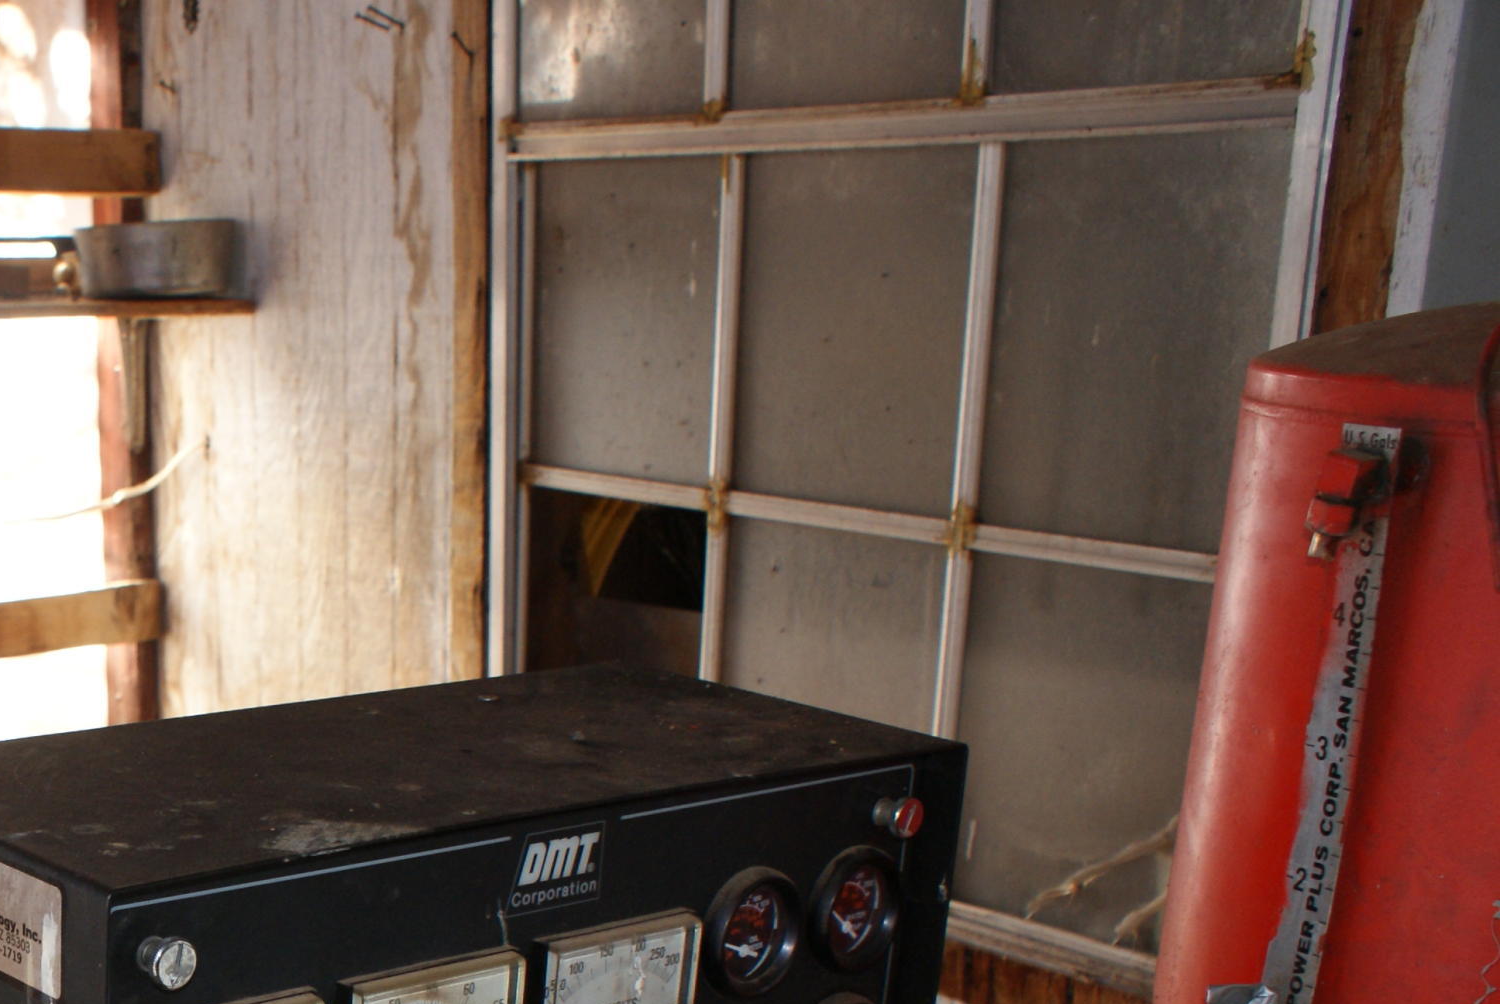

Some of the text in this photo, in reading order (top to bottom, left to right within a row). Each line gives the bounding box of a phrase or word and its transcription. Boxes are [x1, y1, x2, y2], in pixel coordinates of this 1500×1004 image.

[1342, 568, 1372, 689] MARCOS,
[1334, 696, 1353, 749] SAN
[1316, 735, 1328, 761] 3
[1319, 757, 1344, 837] CORP.
[517, 831, 600, 887] DMT
[1306, 845, 1329, 913] PLUS
[511, 880, 597, 908] Corporation
[1293, 867, 1307, 892] 2
[22, 922, 42, 945] Inc.
[463, 982, 475, 996] 60
